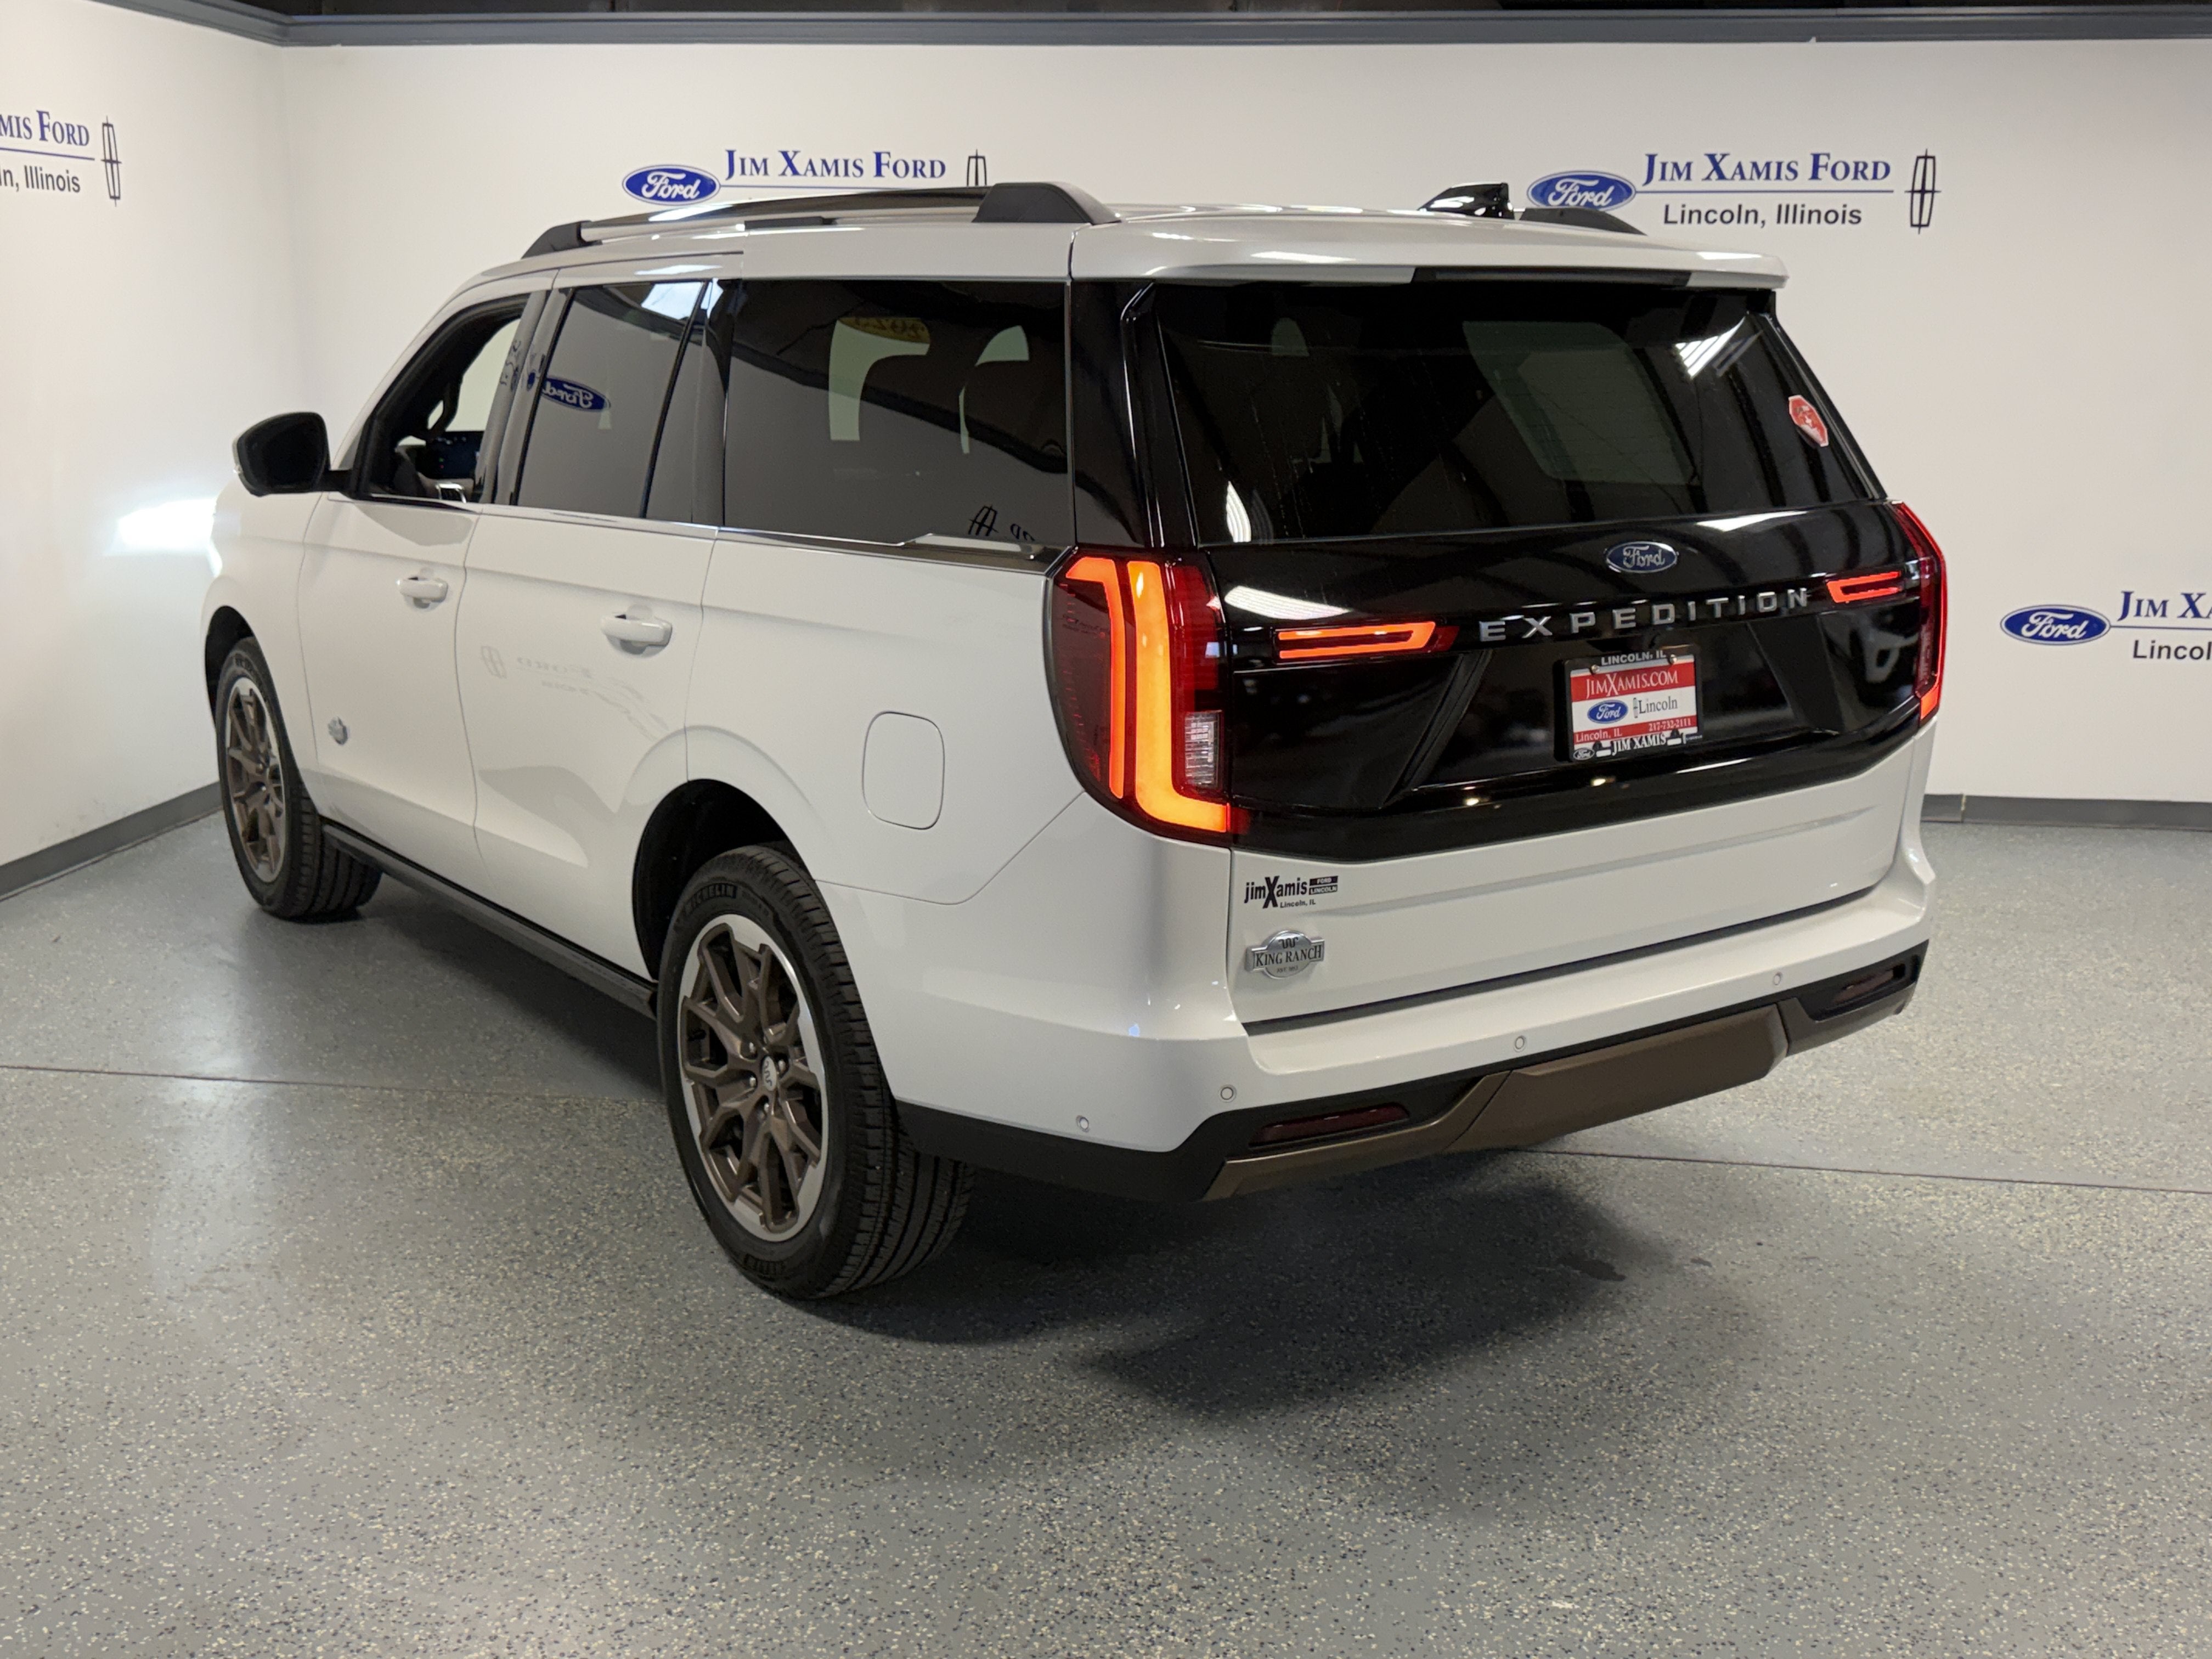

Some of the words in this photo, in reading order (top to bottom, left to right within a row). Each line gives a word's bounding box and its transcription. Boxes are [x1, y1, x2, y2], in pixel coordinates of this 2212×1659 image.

[36, 110, 89, 146] FORD
[24, 165, 81, 193] Illinois
[725, 150, 769, 180] JIM
[778, 150, 864, 178] XAMIS
[872, 151, 946, 179] FORD
[1642, 154, 1692, 187] JIM
[1701, 154, 1799, 181] XAMIS
[1809, 154, 1891, 181] FORD
[641, 172, 700, 200] Ford
[1548, 178, 1615, 207] Ford
[1664, 204, 1766, 228] Lincoln,
[1776, 205, 1863, 224] Illinois
[1623, 546, 1665, 567] Ford
[1479, 587, 1808, 641] EXPEDITION
[2117, 590, 2170, 621] JIM
[2021, 611, 2088, 639] Ford
[1656, 650, 1667, 658] IL
[1639, 696, 1678, 714] Lincoln
[1612, 737, 1631, 755] JIM
[1633, 733, 1666, 750] XAMIS
[1613, 727, 1622, 737] IL
[1244, 876, 1308, 909] jimXamis
[1311, 885, 1337, 894] LINCOLN
[1256, 951, 1283, 967] KING
[1285, 945, 1322, 963] RANCH
